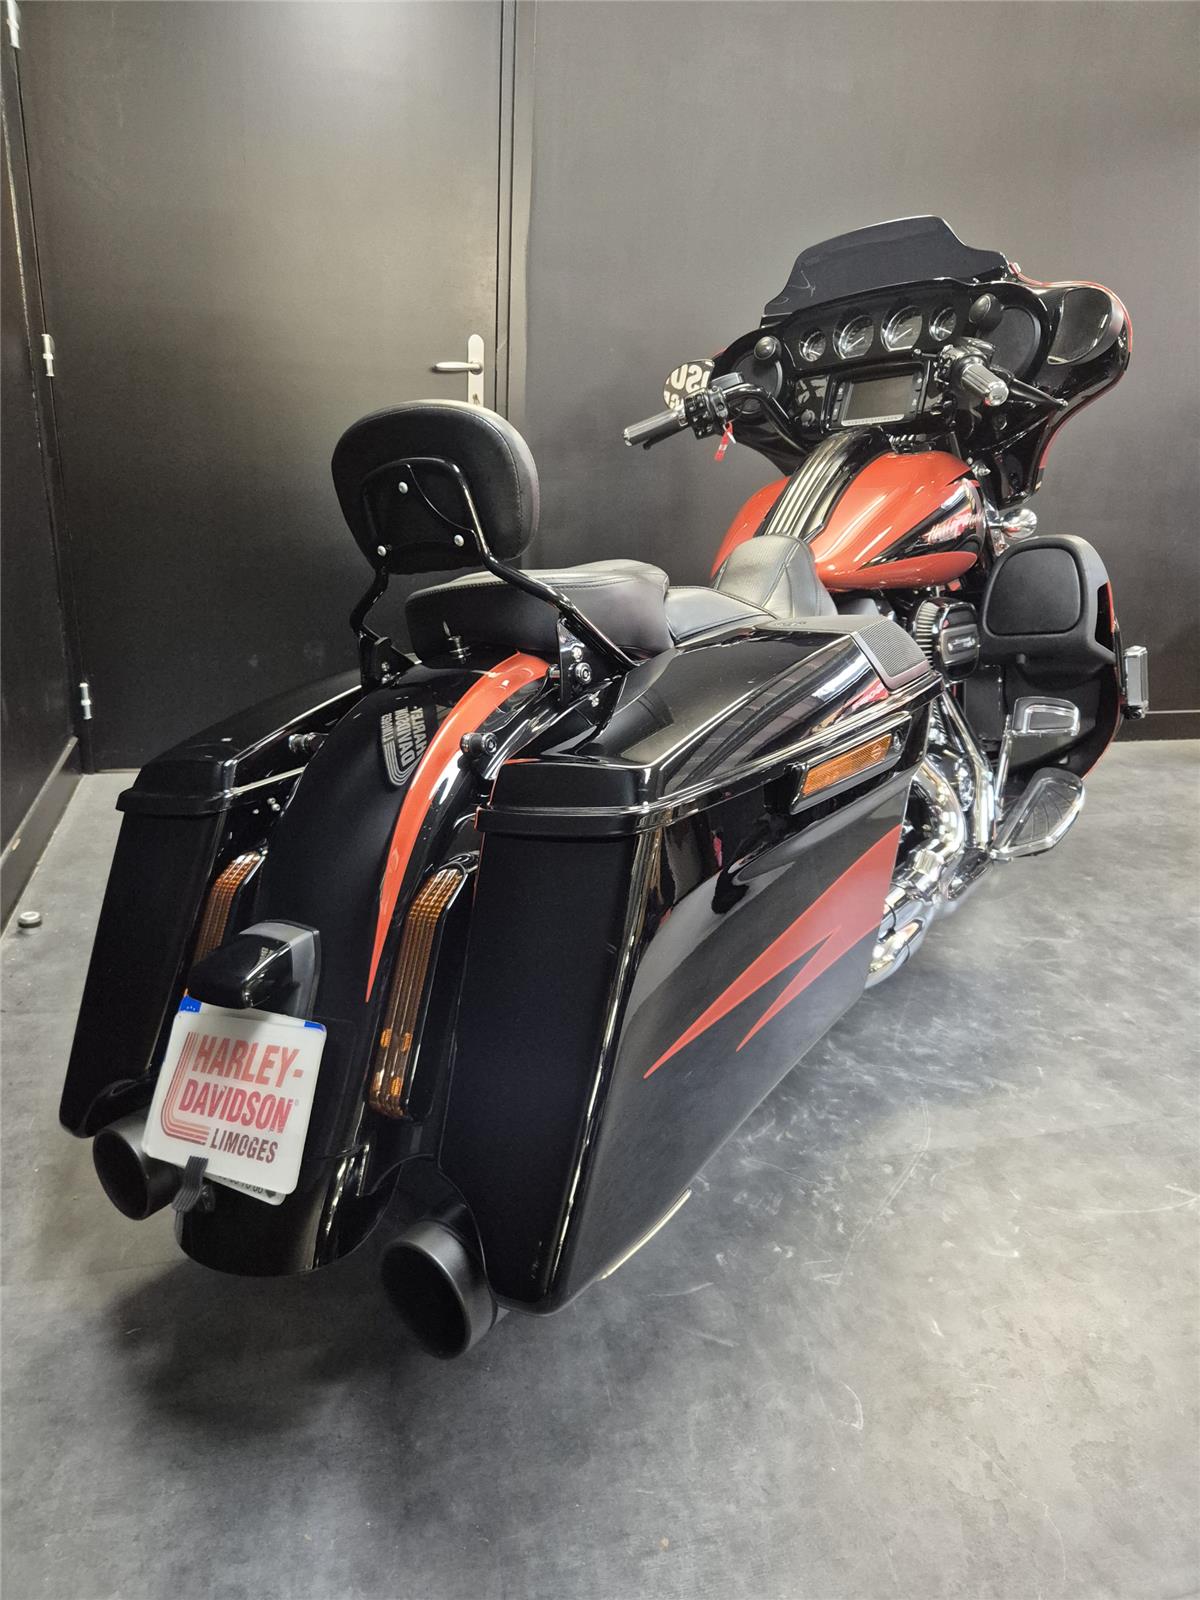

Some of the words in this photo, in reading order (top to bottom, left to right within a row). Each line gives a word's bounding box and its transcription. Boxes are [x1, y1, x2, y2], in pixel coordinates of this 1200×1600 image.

[191, 1033, 304, 1088] HARLEY-
[178, 1078, 294, 1134] DAVIDSON
[209, 1128, 279, 1164] LIMOGES
